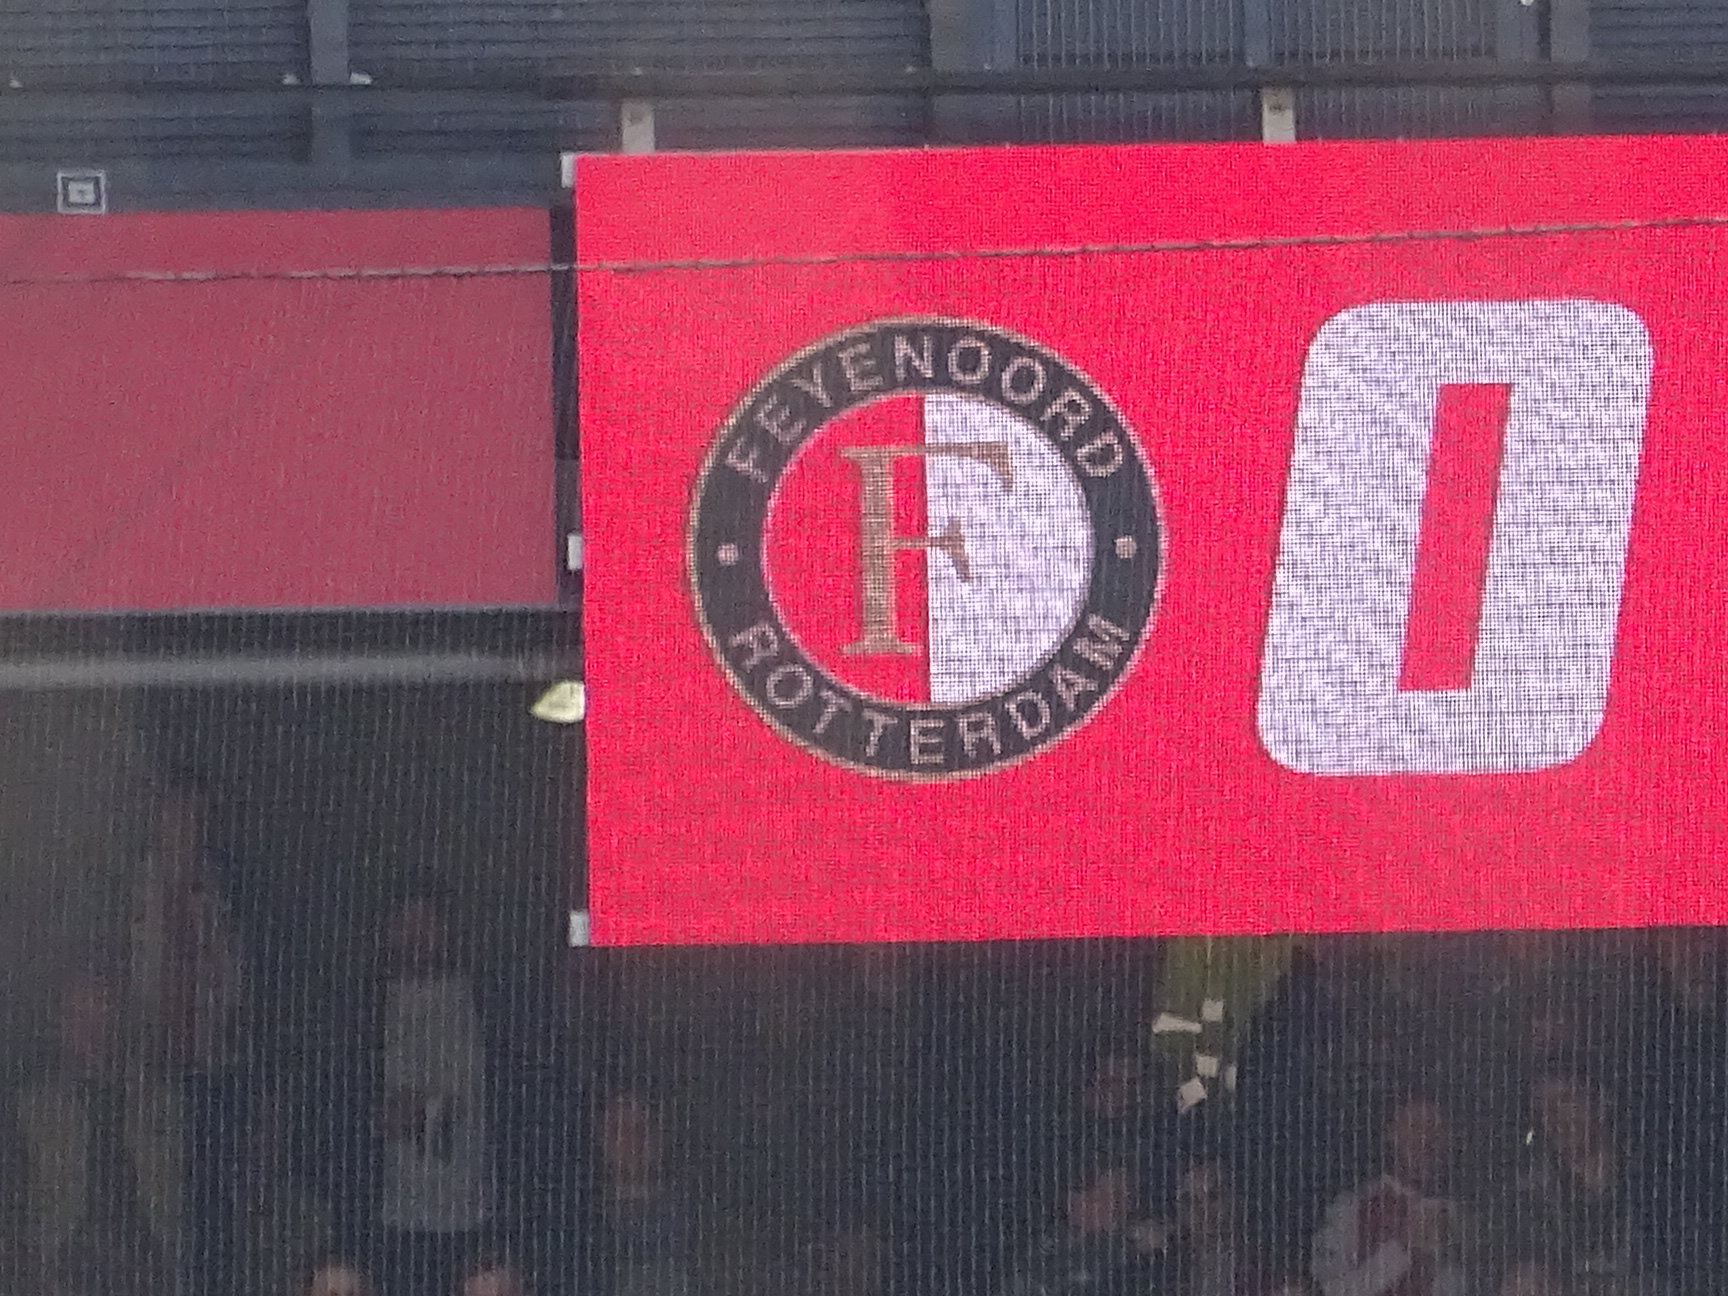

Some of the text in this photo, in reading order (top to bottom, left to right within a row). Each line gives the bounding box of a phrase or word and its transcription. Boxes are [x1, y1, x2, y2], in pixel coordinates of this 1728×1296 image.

[725, 333, 1124, 485] FEYENOORD
[1256, 300, 1655, 777] 0
[728, 615, 1131, 766] ROTTERDAM
